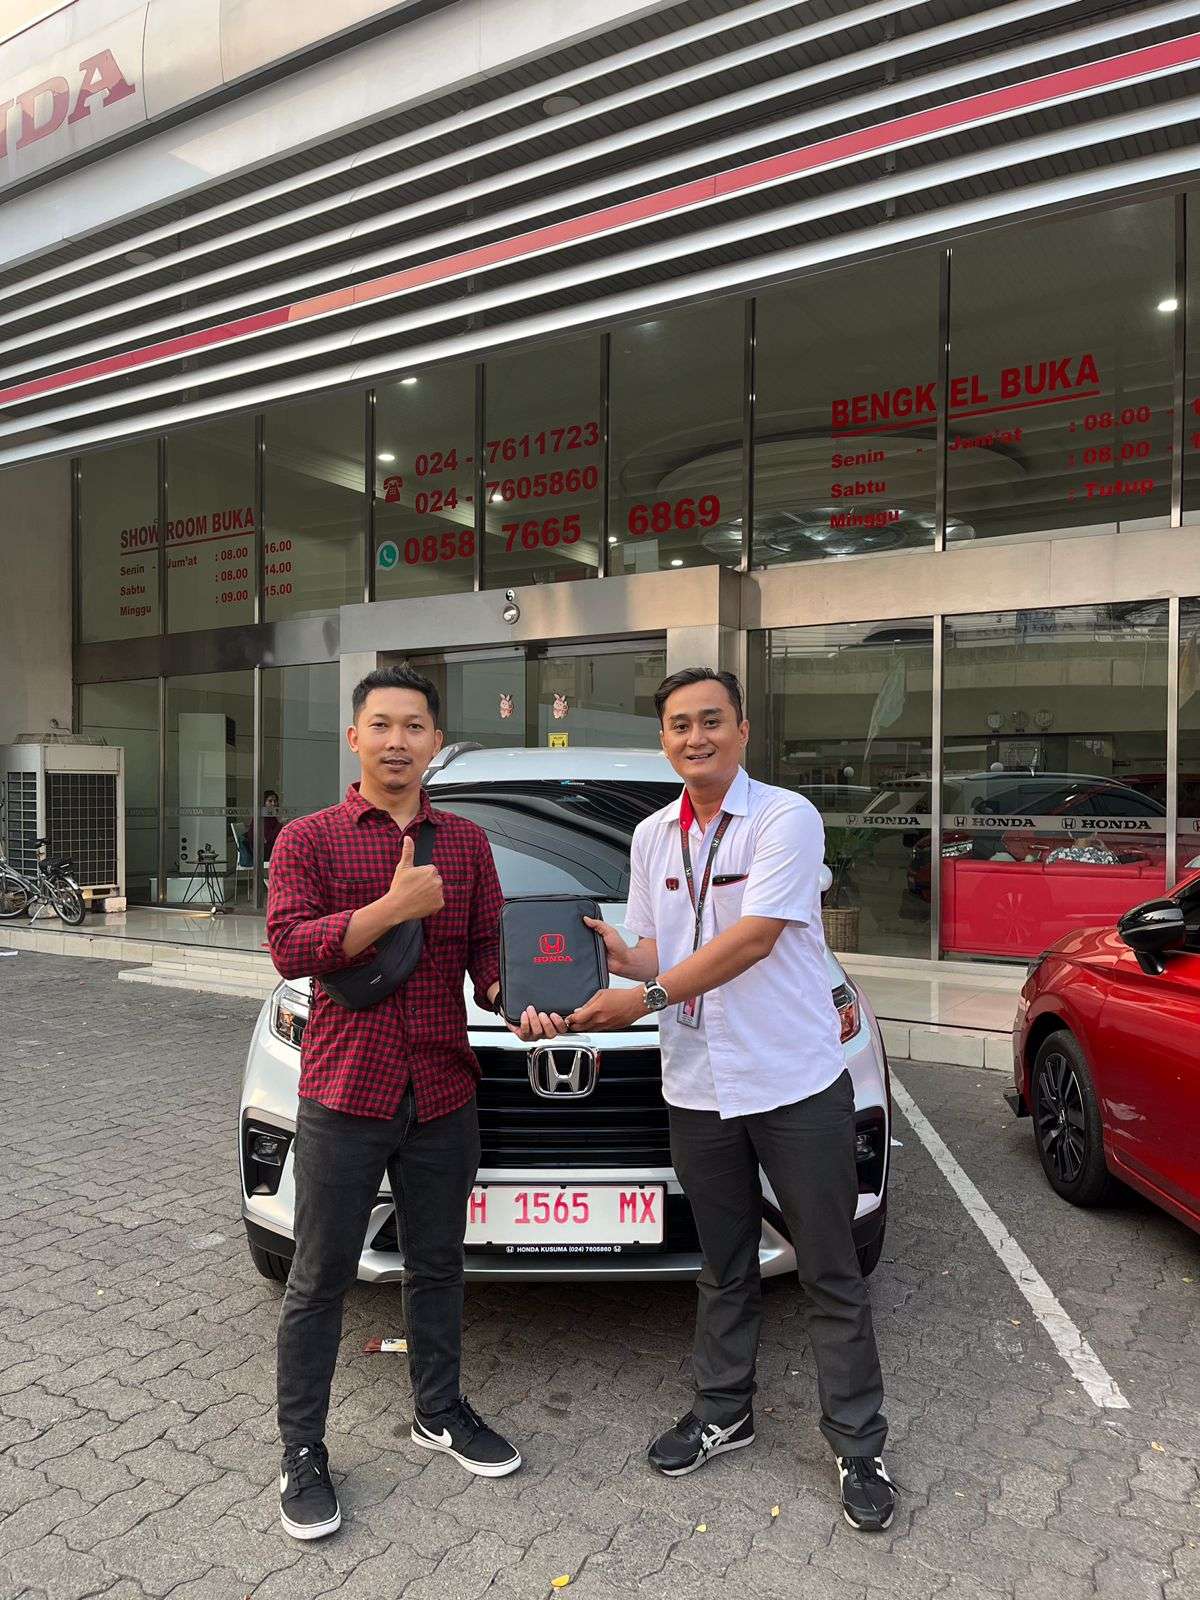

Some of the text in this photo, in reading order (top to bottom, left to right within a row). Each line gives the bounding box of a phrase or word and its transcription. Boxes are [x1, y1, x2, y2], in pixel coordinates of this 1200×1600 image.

[0, 48, 136, 159] DA
[1000, 353, 1100, 400] BUKA
[415, 449, 458, 476] 024
[486, 422, 600, 464] 7611723
[831, 449, 885, 469] Senin
[1083, 405, 1151, 431] 08.00
[831, 480, 886, 498] Sabtu
[1083, 441, 1151, 465] 08.00
[415, 487, 458, 514] 024
[485, 465, 599, 504] 7605860
[212, 507, 256, 533] BUKA
[404, 494, 721, 564] 0858 7665 6869
[829, 509, 901, 529] Minggu
[120, 564, 145, 577] Senin
[221, 547, 248, 561] 08.00
[264, 540, 292, 554] 16.00
[120, 584, 146, 597] Sabtu
[221, 568, 248, 581] 08.00
[264, 561, 292, 575] 14.00
[120, 605, 152, 617] Minggu
[221, 590, 249, 603] 09.00
[264, 583, 293, 597] 15.00
[863, 816, 921, 826] HONDA
[971, 817, 1036, 828] HONDA
[1081, 819, 1152, 830] HONDA
[514, 1192, 591, 1224] 1565
[619, 1191, 656, 1224] MX
[568, 1246, 584, 1254] (024)
